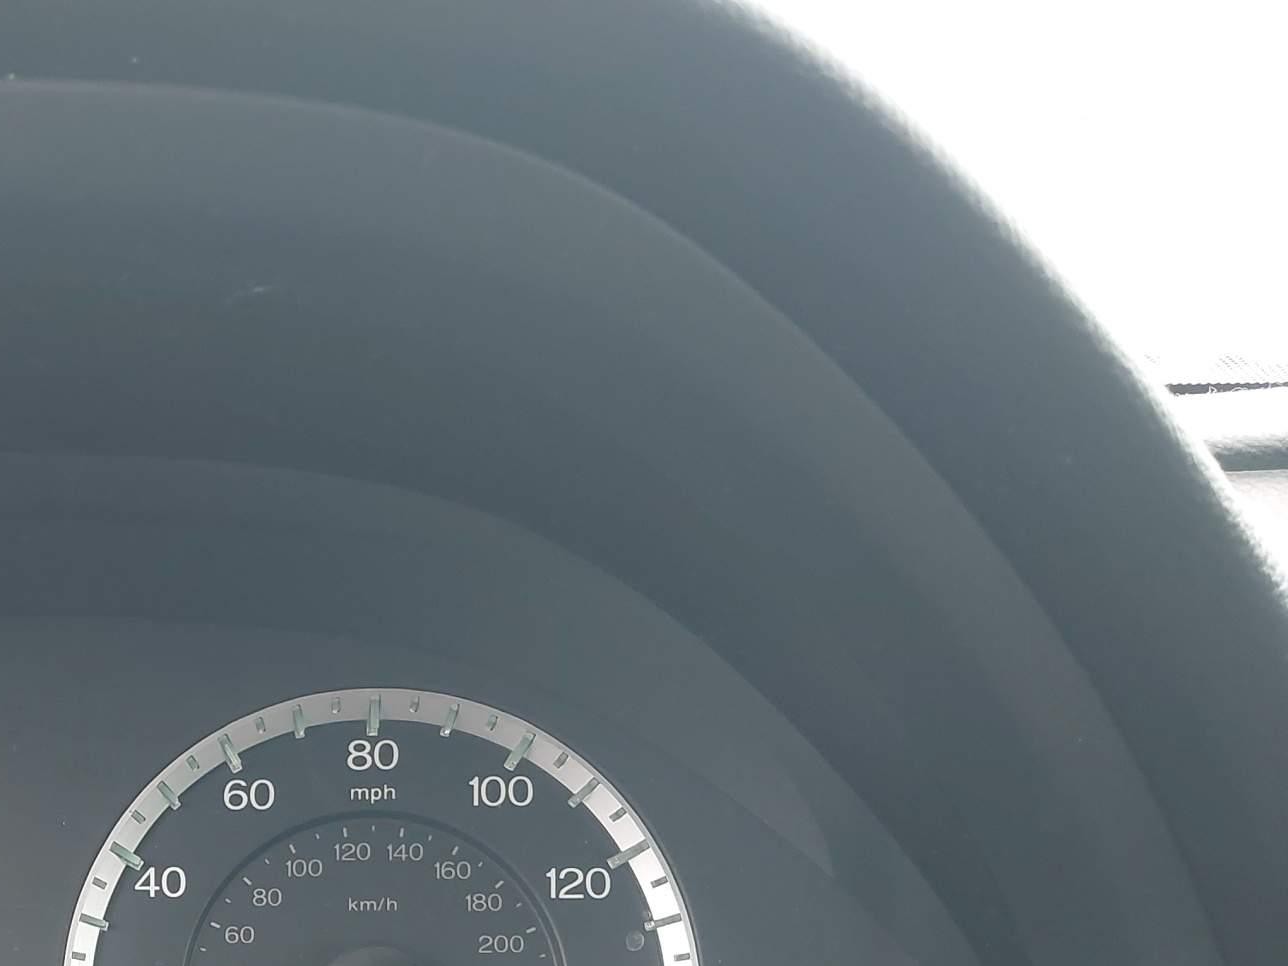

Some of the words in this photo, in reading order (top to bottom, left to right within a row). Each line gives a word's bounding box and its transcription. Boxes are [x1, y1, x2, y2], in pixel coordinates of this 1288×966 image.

[348, 740, 398, 770] 80
[224, 780, 274, 810] 60
[351, 785, 395, 803] mph
[469, 776, 533, 806] 100
[335, 843, 370, 860] 120
[388, 843, 423, 860] 140
[286, 860, 322, 877] 100
[435, 862, 470, 879] 160
[134, 866, 186, 897] 40
[546, 868, 611, 898] 120
[253, 889, 281, 906] 80
[349, 898, 397, 911] km/h
[466, 894, 502, 911] 180
[225, 927, 254, 943] 60
[479, 936, 523, 953] 200
